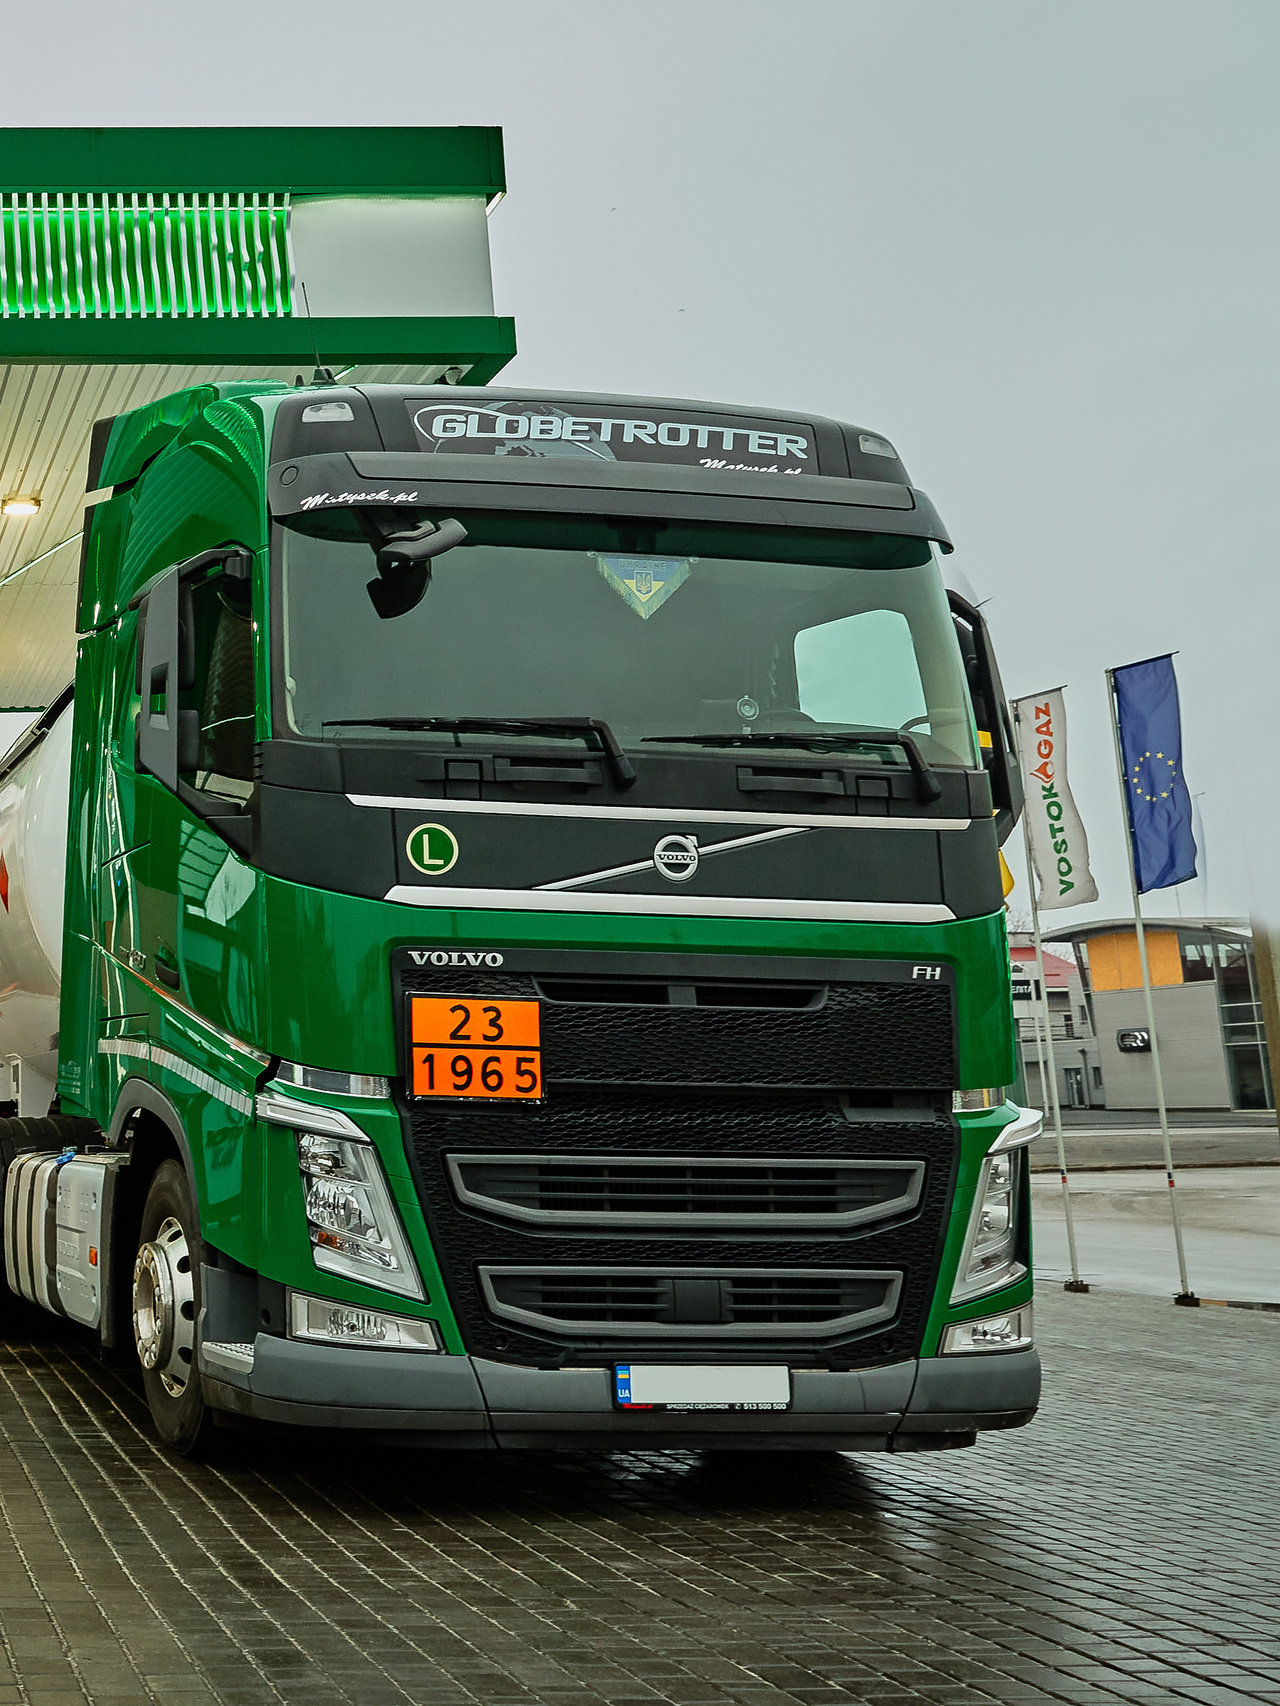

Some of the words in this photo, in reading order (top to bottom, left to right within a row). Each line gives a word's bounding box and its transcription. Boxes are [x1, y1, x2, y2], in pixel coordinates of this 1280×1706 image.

[431, 413, 808, 460] GLOBETROTTER
[1034, 702, 1054, 760] GAZ
[423, 833, 445, 865] L
[1041, 781, 1075, 897] VOSTOK
[656, 853, 697, 863] VOLVO
[407, 950, 504, 967] VOLVO
[912, 966, 942, 980] FH
[449, 1004, 504, 1042] 23
[422, 1053, 538, 1093] 1965
[618, 1389, 630, 1398] UA
